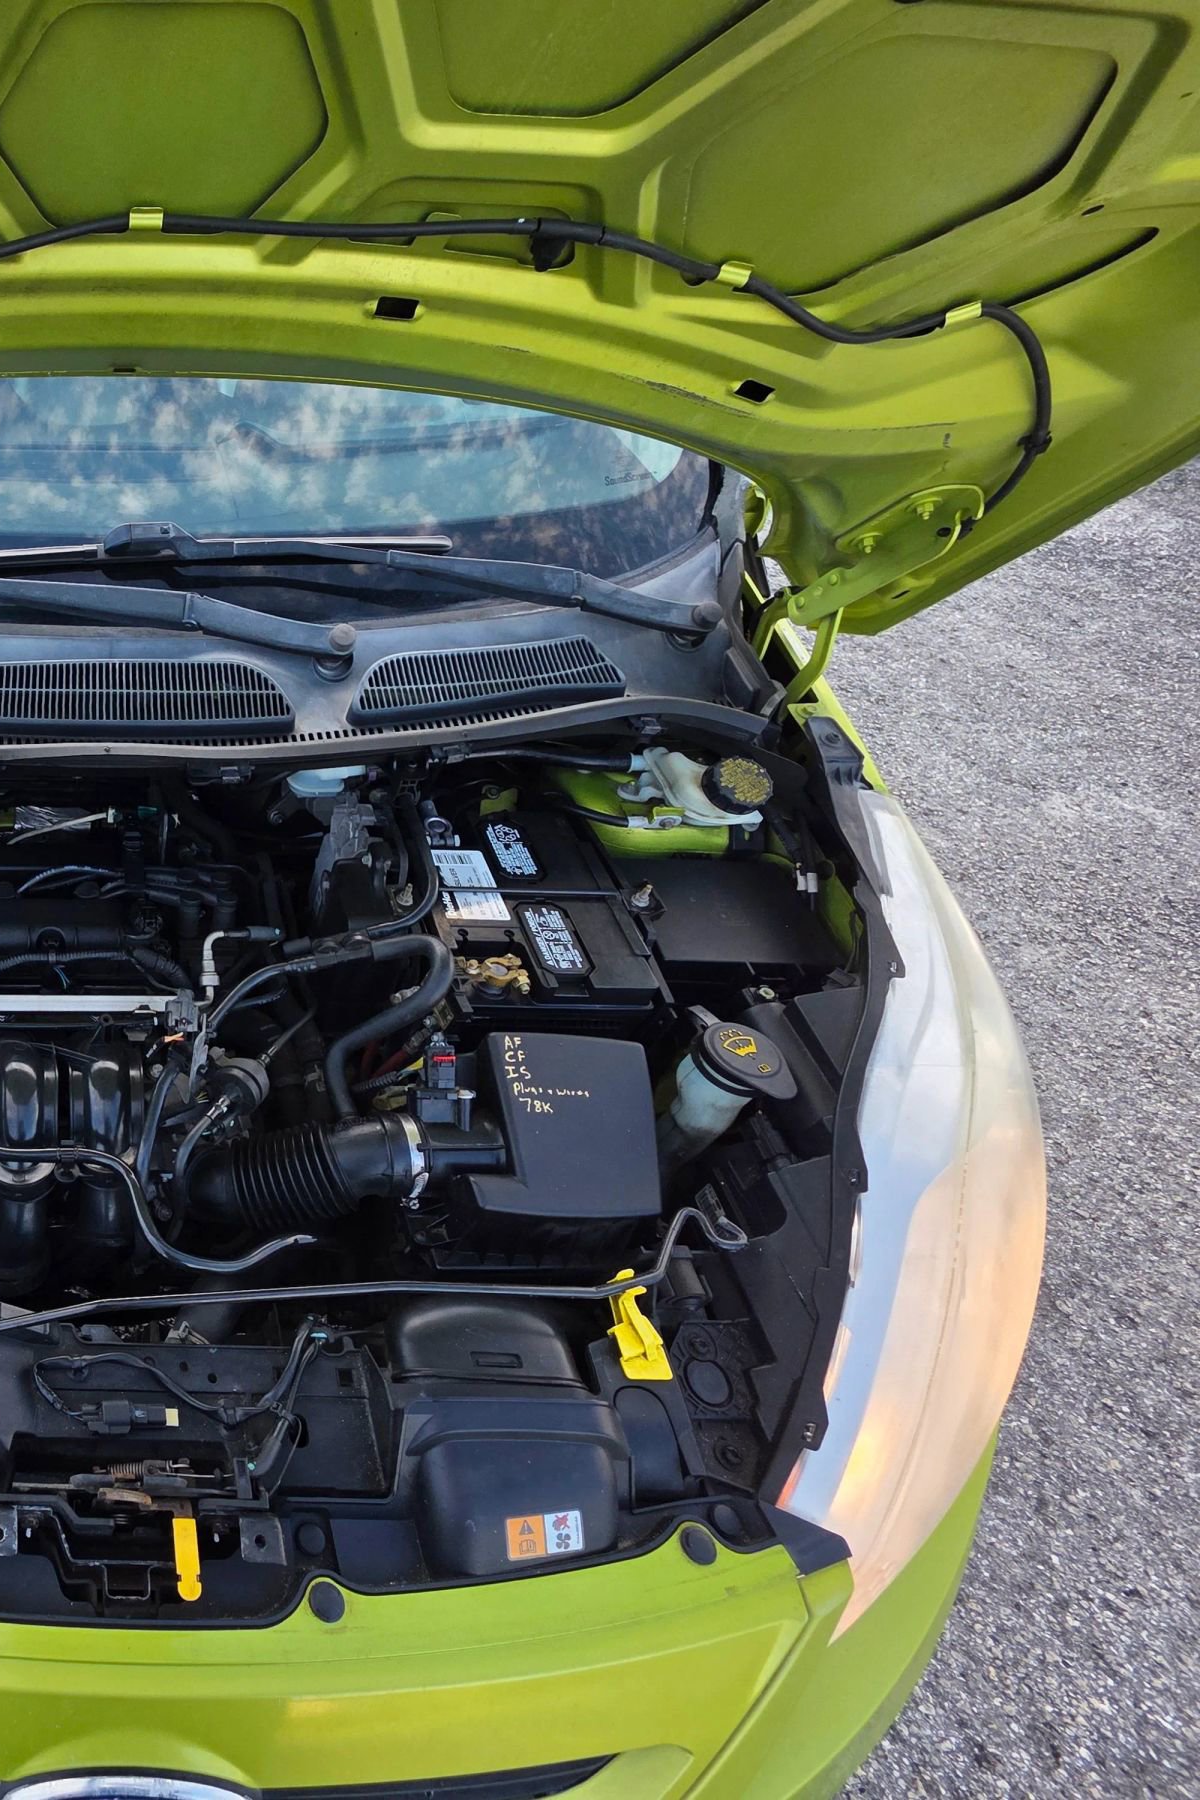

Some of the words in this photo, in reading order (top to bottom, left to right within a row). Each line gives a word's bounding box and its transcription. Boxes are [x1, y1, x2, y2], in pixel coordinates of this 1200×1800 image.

[504, 1035, 521, 1050] AF
[504, 1050, 526, 1062] CF
[504, 1066, 531, 1079] IS
[519, 1098, 554, 1114] 78K
